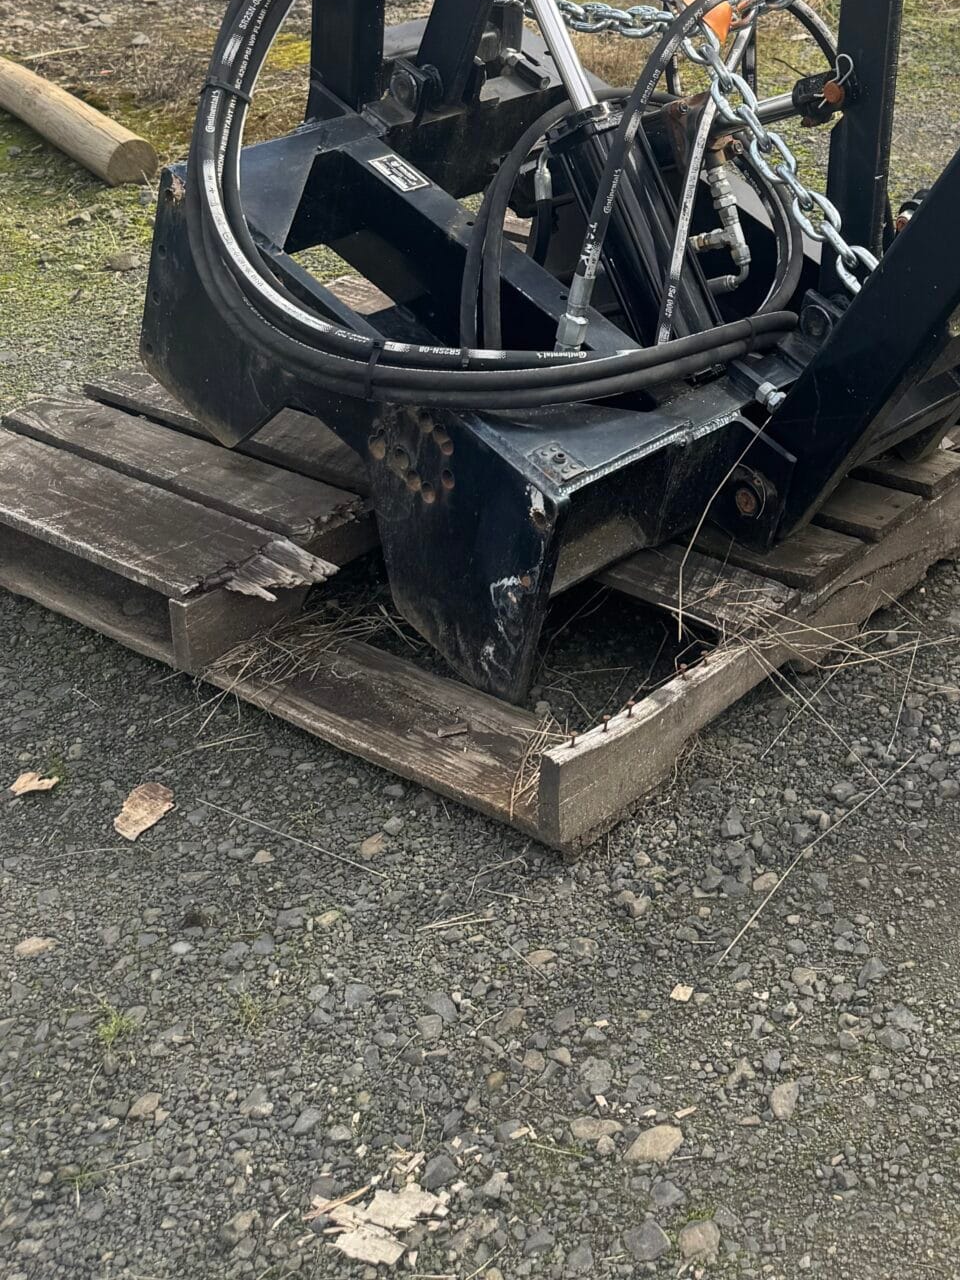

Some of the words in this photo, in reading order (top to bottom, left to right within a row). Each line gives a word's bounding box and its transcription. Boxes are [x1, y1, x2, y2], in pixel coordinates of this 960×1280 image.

[205, 93, 220, 133] Continental
[603, 173, 621, 214] Continental
[668, 285, 677, 300] PSI
